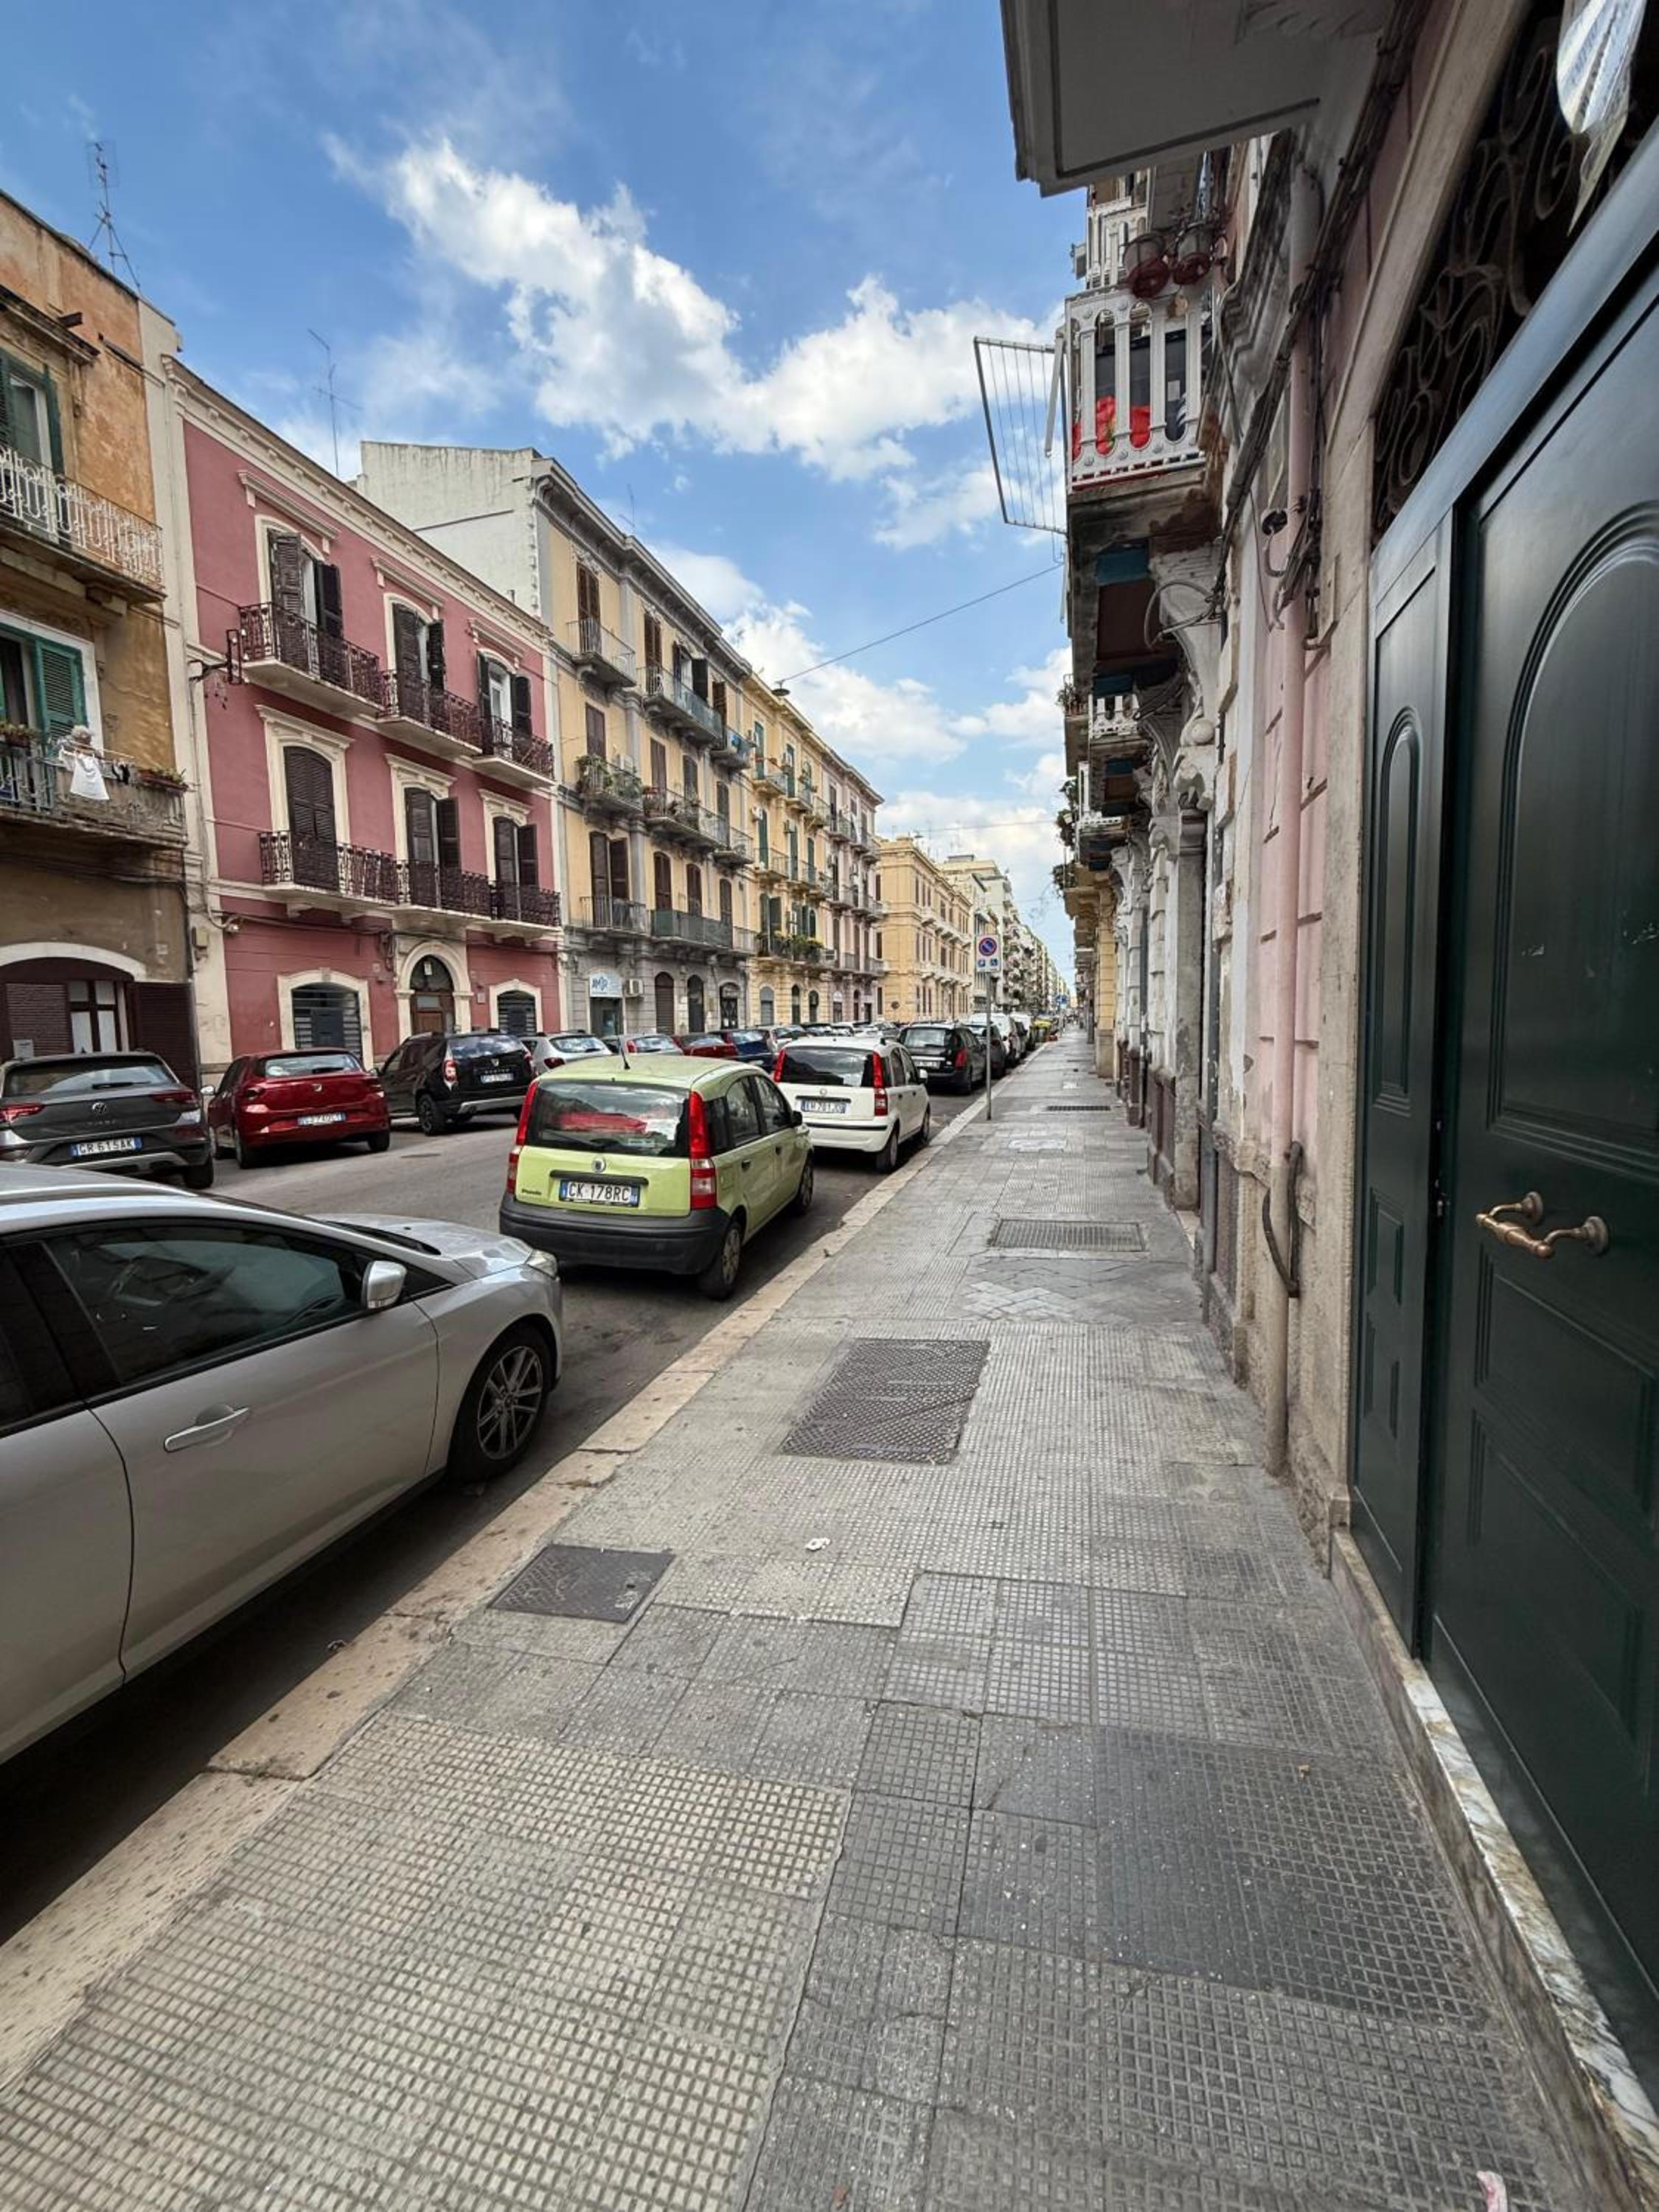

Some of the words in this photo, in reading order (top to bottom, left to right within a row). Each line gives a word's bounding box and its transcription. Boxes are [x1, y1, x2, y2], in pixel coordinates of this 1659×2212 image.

[80, 1144, 94, 1153] GR
[568, 1183, 584, 1197] CK
[591, 1185, 630, 1200] 178RC
